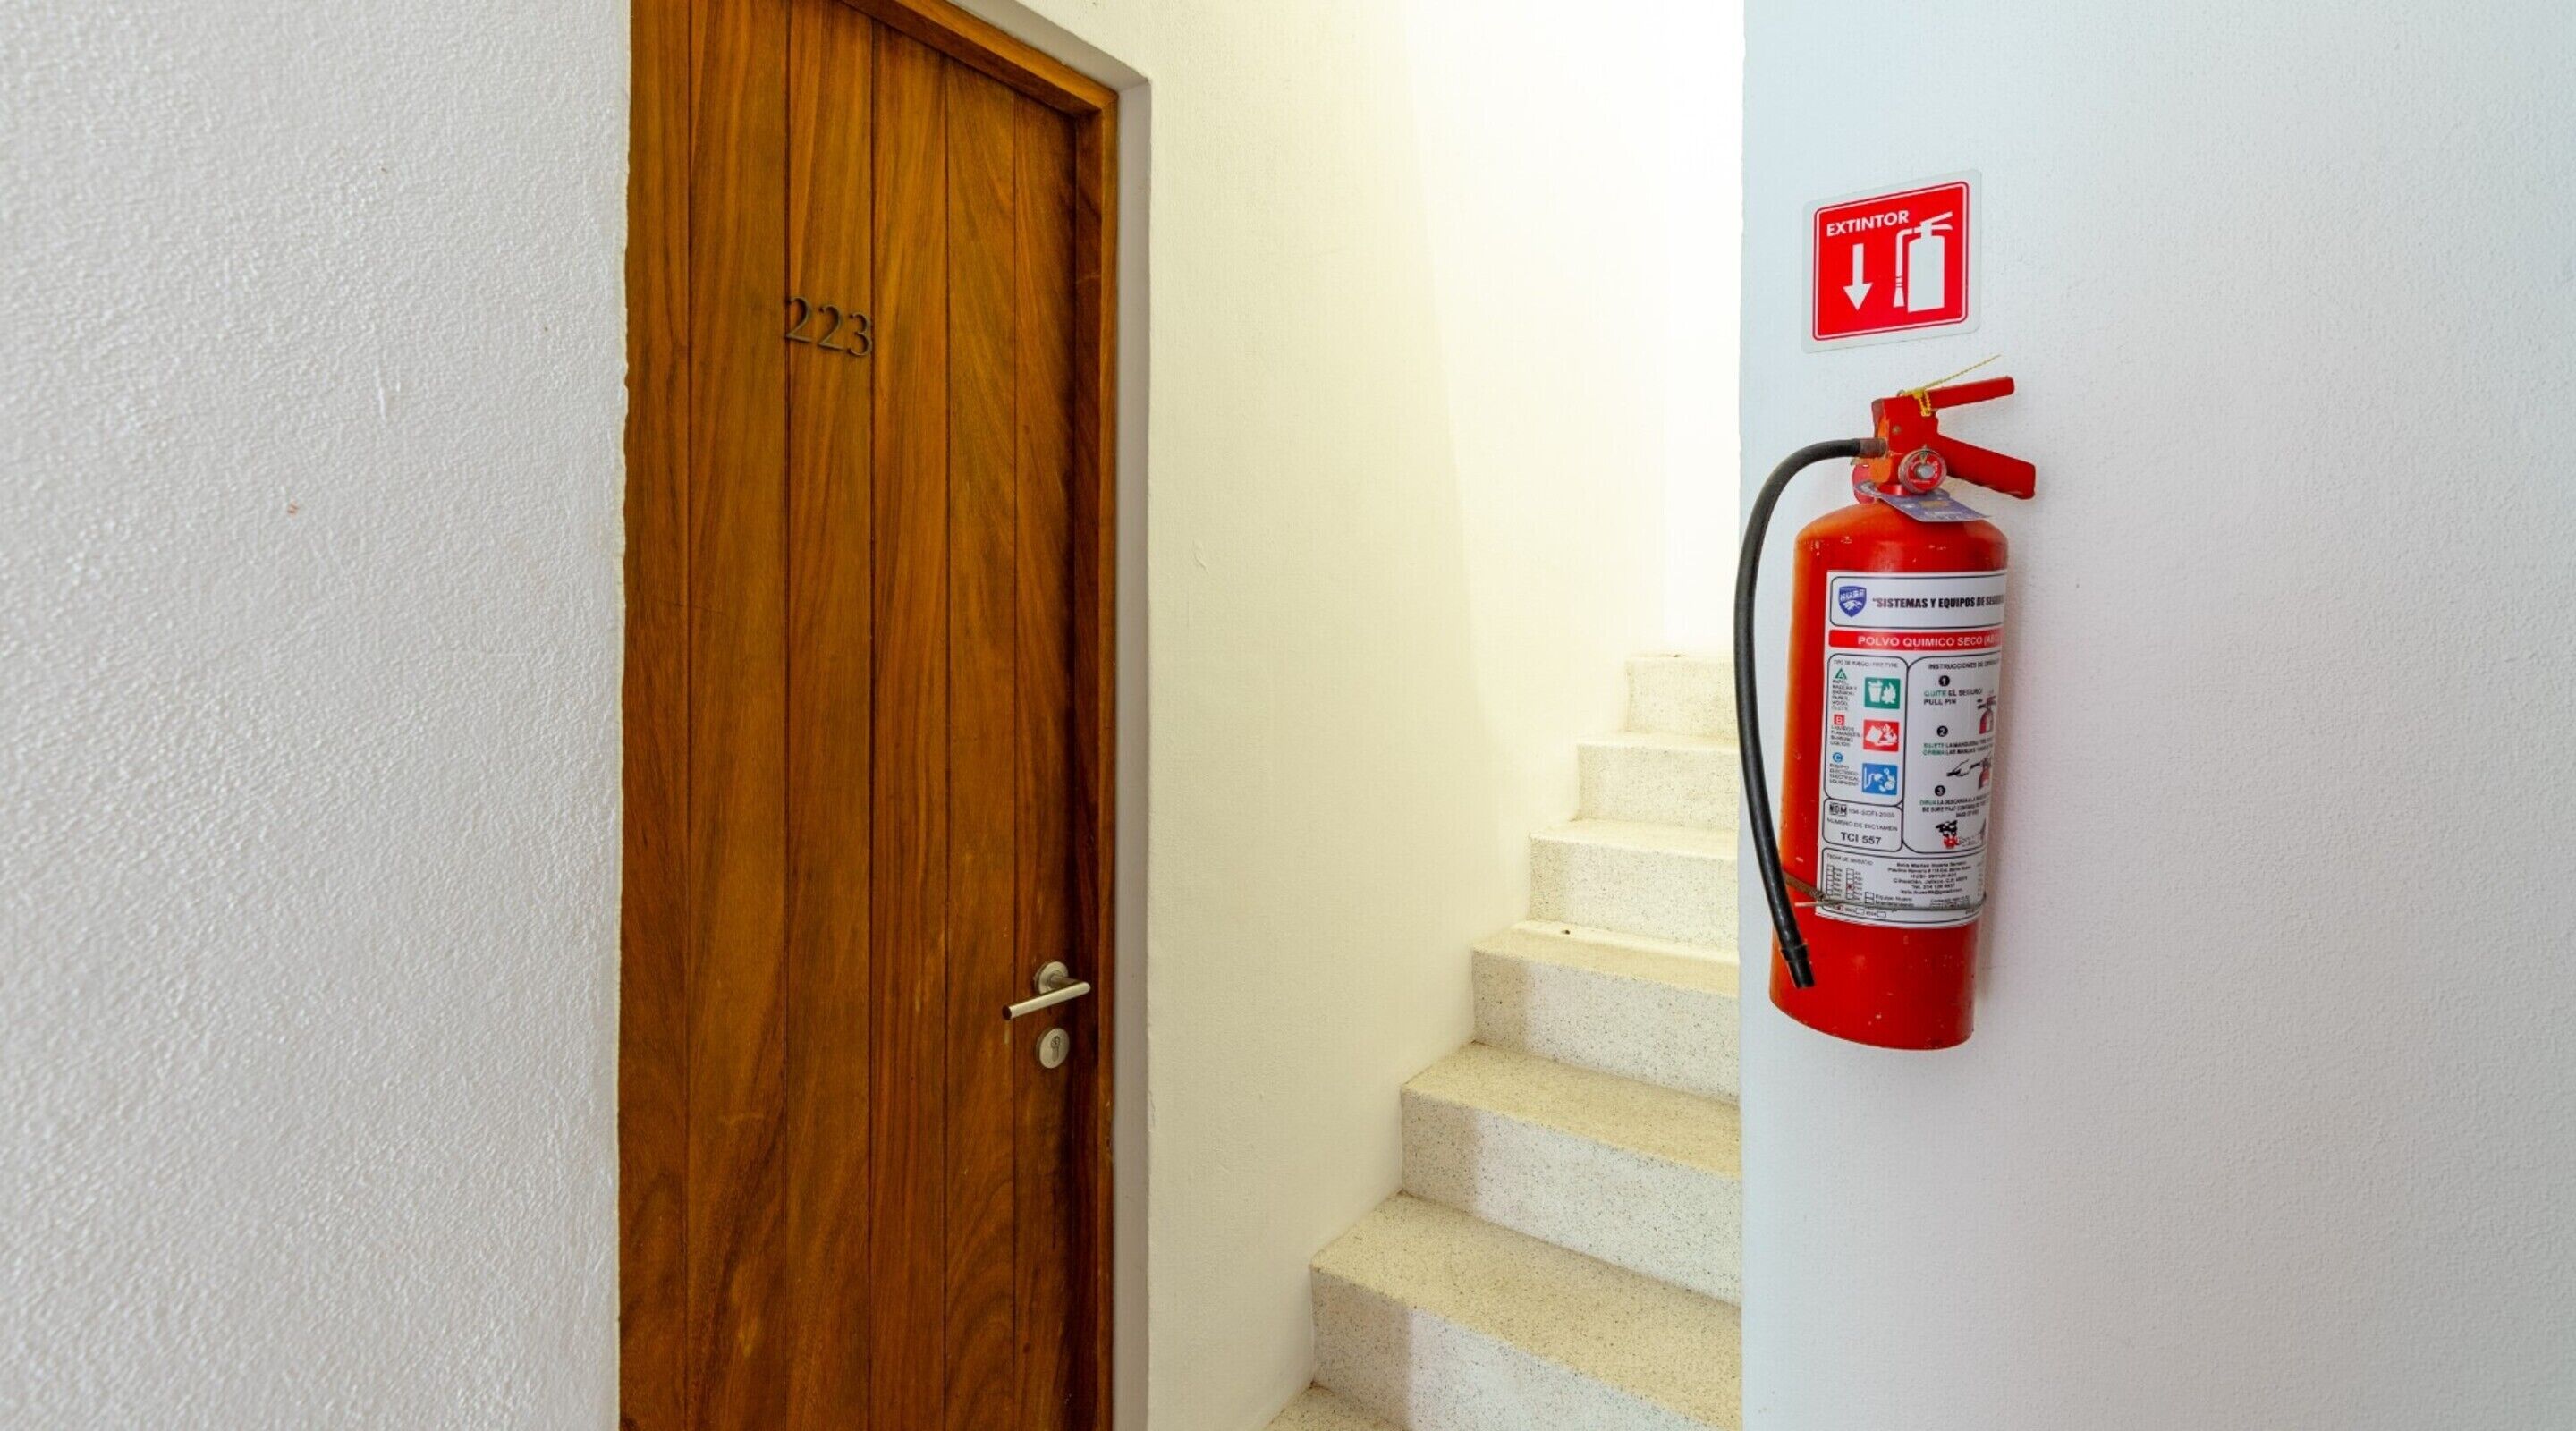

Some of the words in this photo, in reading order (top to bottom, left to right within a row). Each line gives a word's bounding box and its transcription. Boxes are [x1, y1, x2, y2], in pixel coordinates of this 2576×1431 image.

[1826, 210, 1910, 236] EXTINTOR
[784, 297, 873, 357] 223
[1930, 597, 1936, 608] Y
[1938, 597, 1976, 608] EQUIPOS
[1977, 597, 1985, 606] DE
[1858, 636, 1900, 646] POLVO
[1902, 637, 1955, 647] QUIMICO
[1957, 636, 1983, 646] SECO
[1841, 832, 1859, 843] TCI
[1862, 835, 1882, 845] 557
